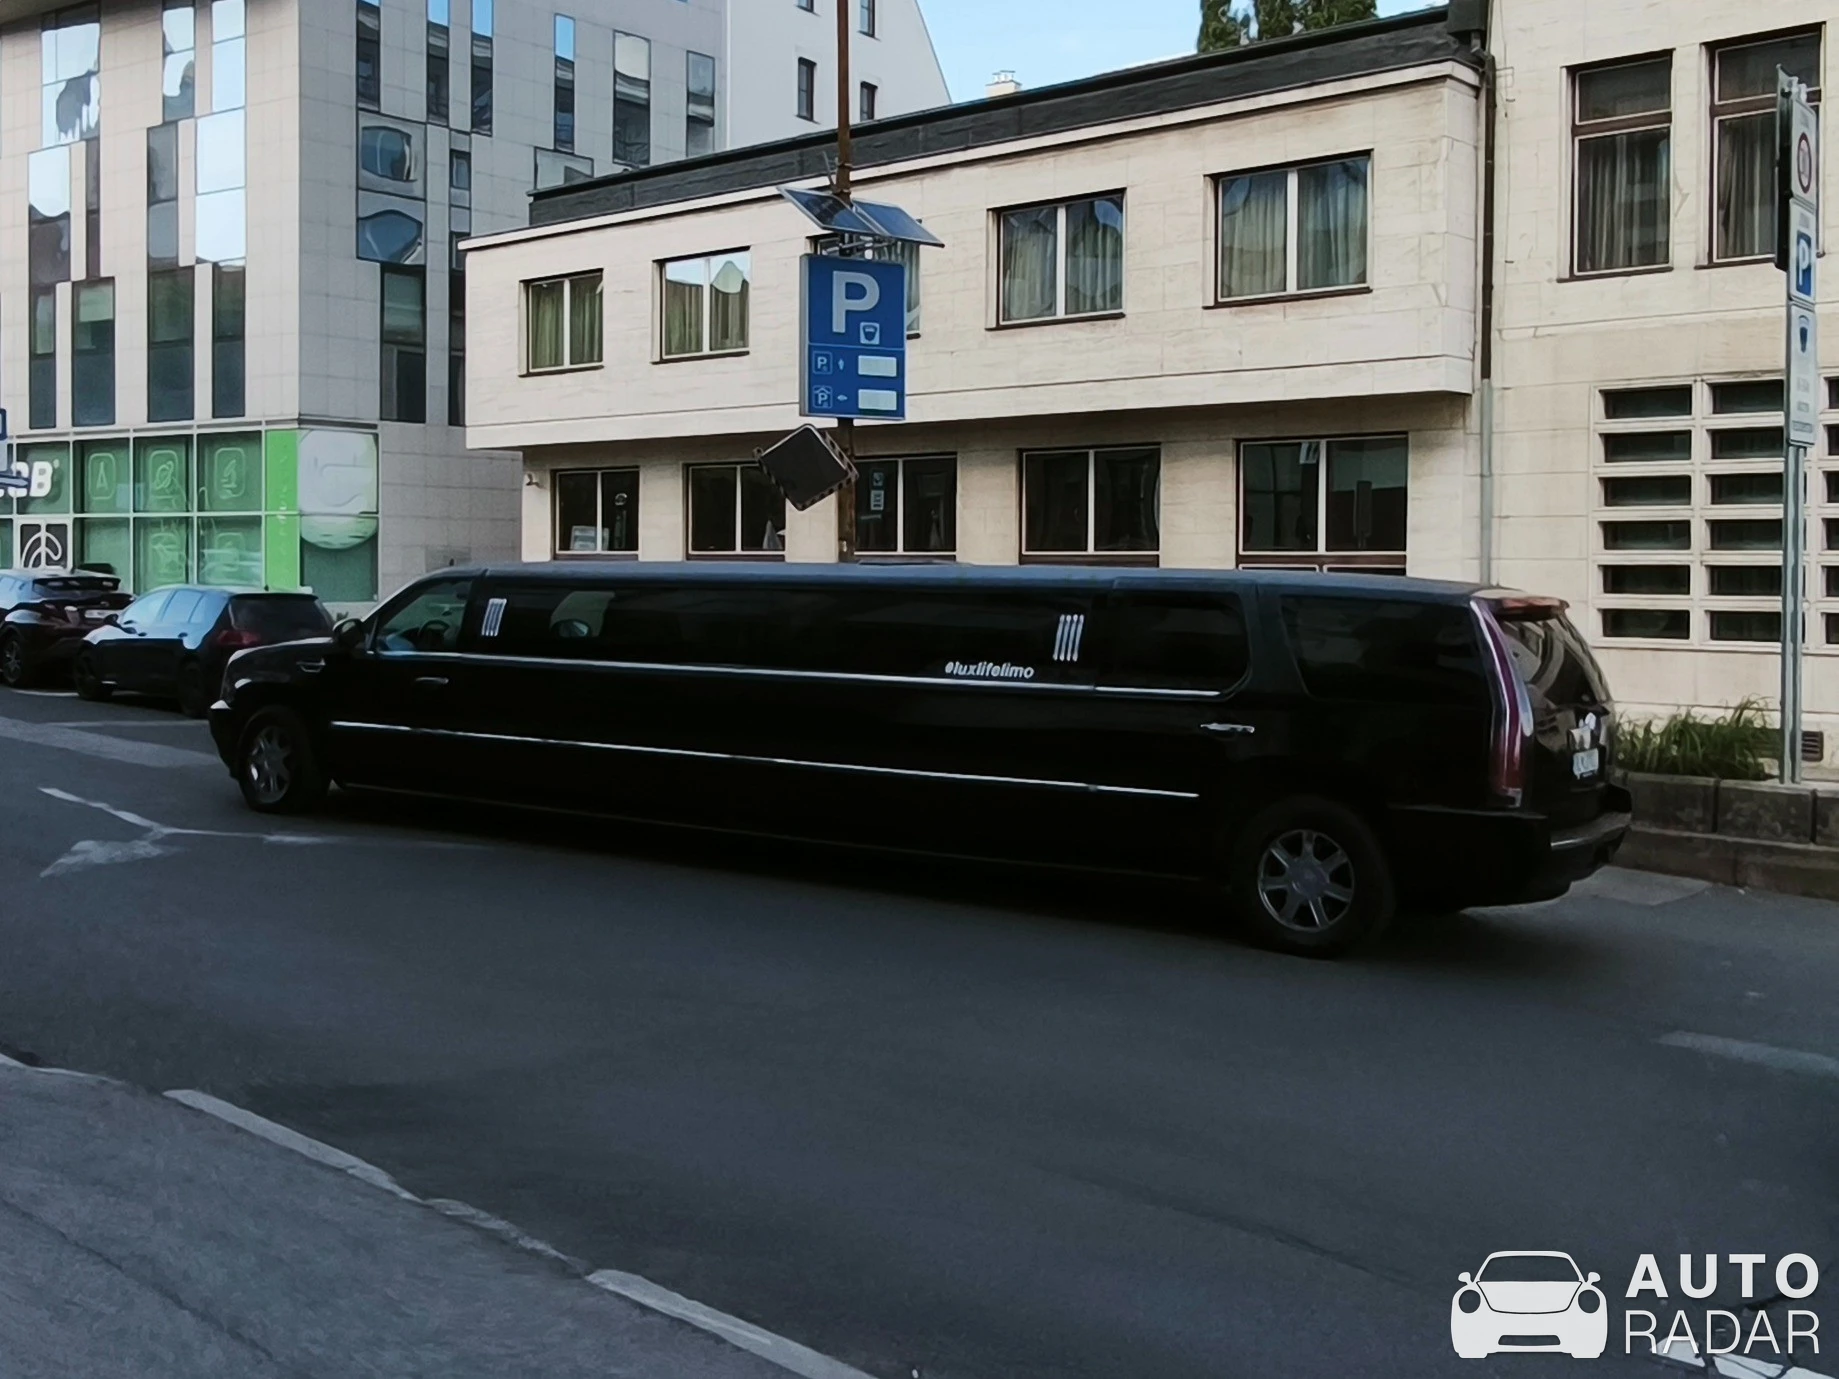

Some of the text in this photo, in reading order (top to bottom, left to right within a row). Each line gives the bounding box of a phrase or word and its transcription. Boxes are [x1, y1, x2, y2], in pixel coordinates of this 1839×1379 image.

[1798, 238, 1809, 286] P
[832, 271, 880, 334] P
[817, 356, 828, 369] P
[818, 392, 829, 405] P
